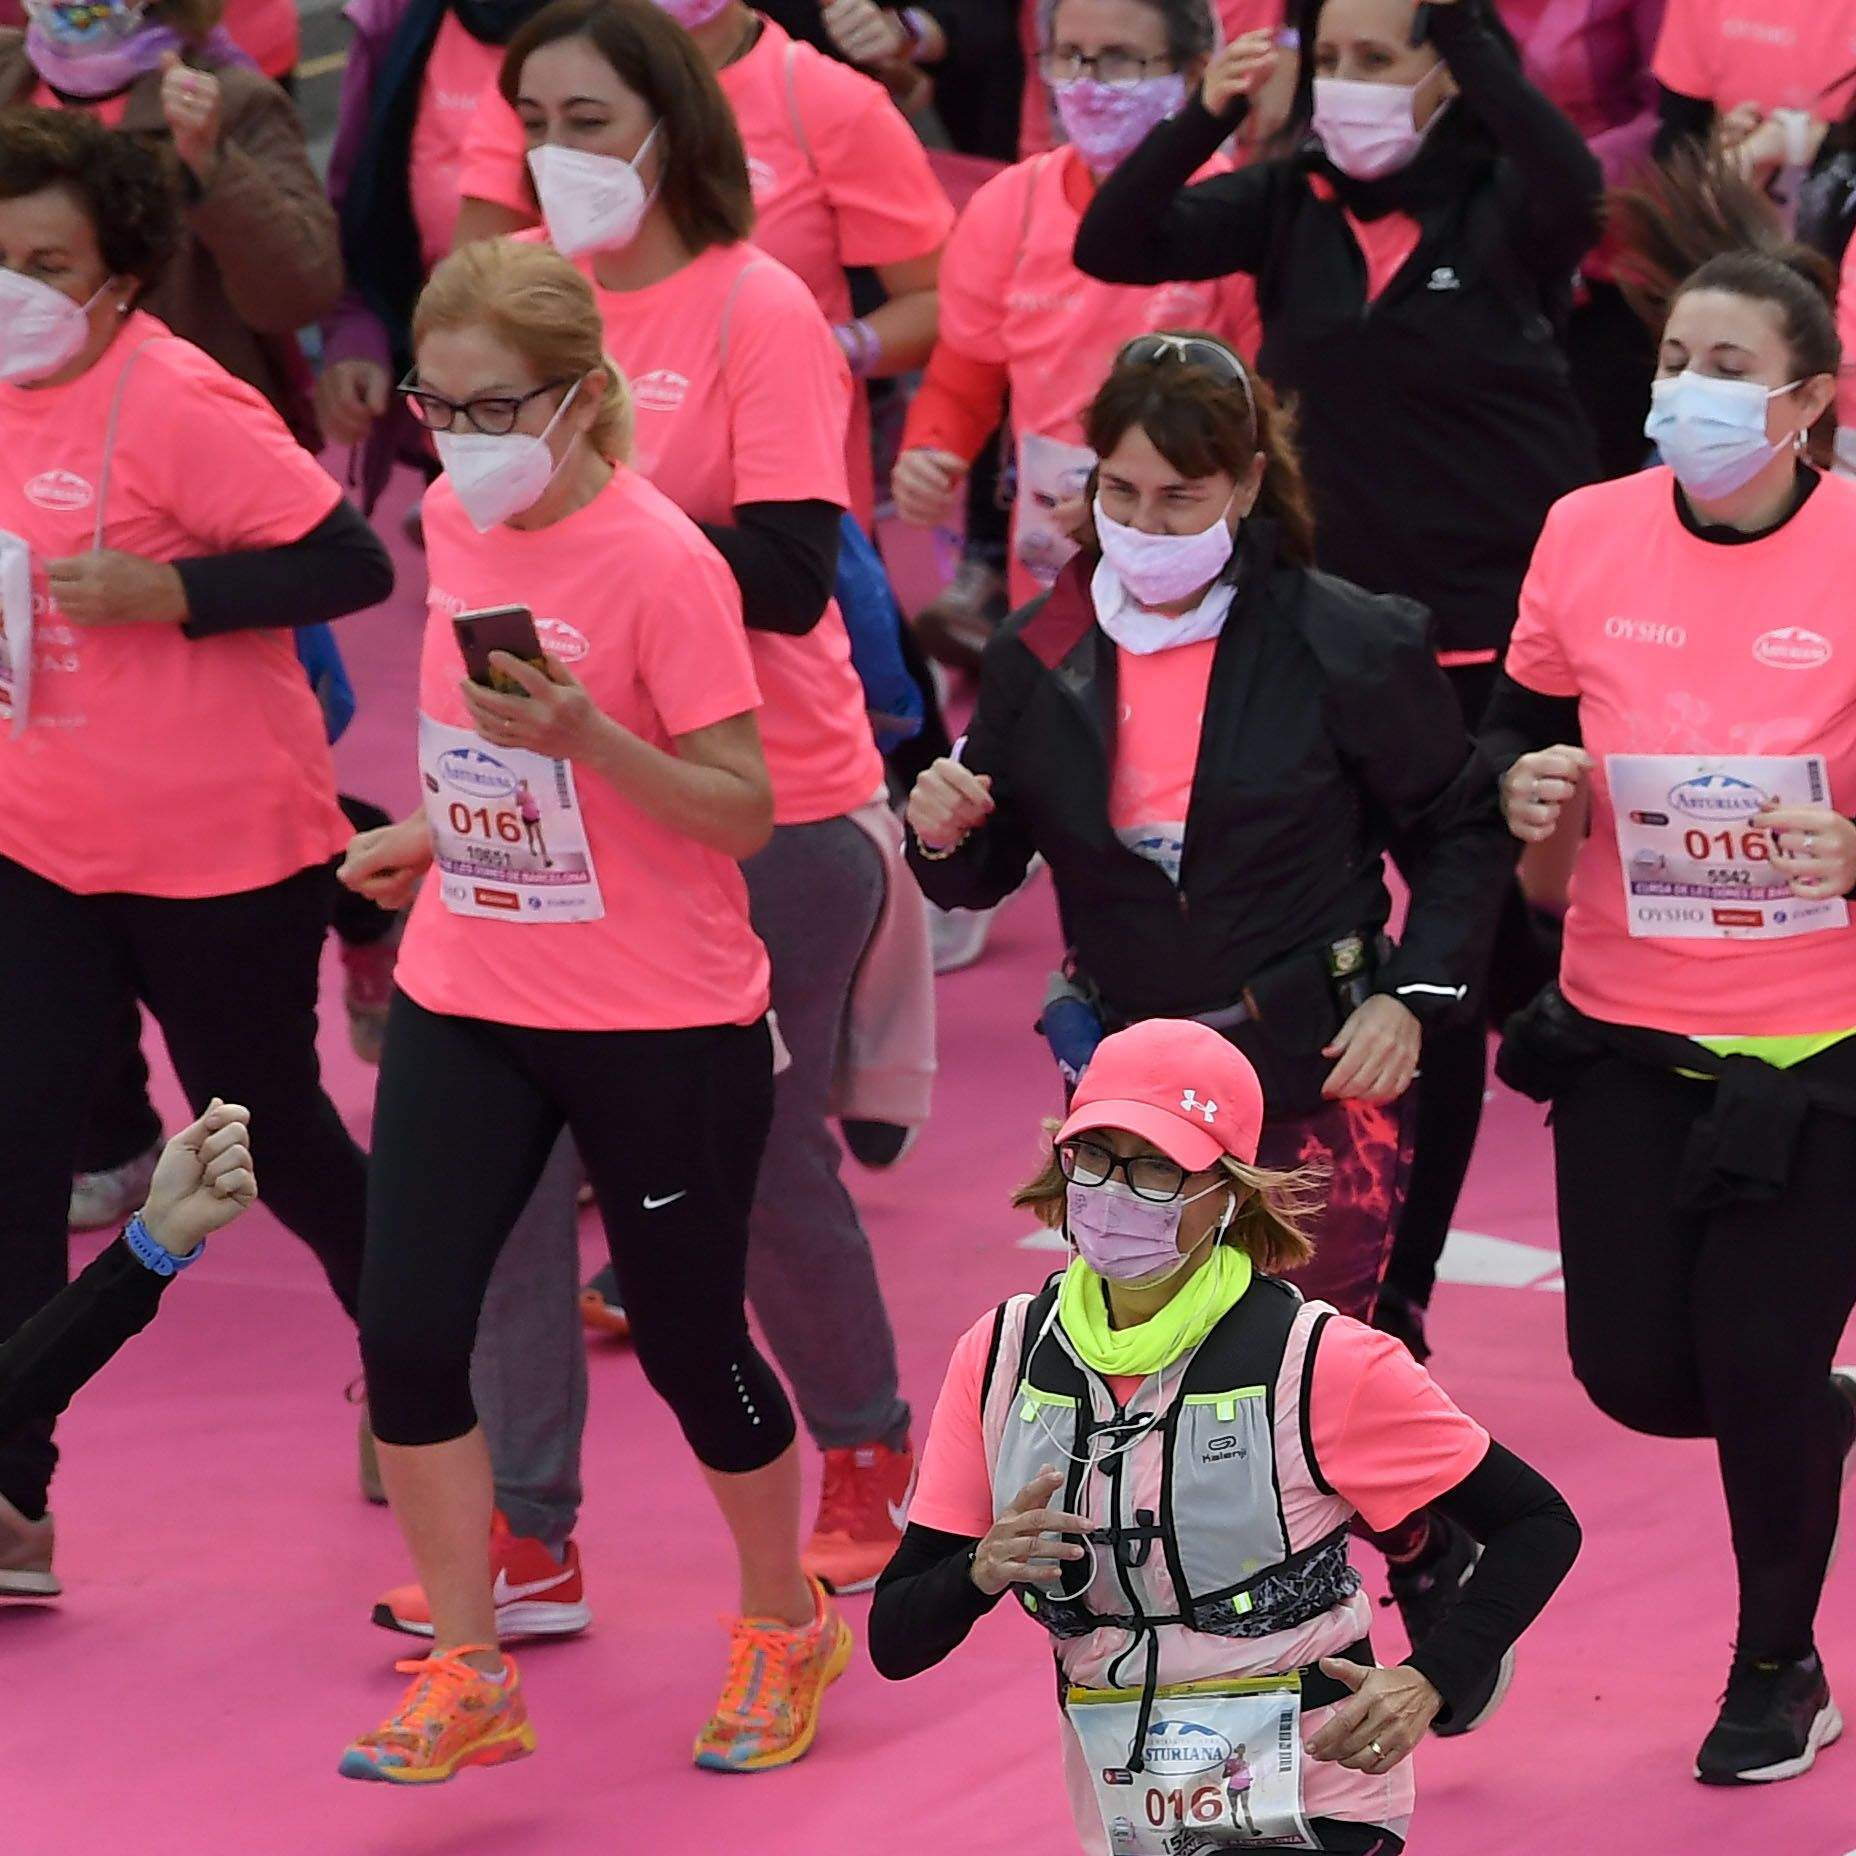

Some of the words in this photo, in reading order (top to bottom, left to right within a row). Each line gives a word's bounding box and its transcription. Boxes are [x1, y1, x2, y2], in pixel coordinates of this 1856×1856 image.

[1605, 616, 1688, 649] OYSHO
[449, 802, 522, 844] 016
[1684, 829, 1770, 862] 016
[1707, 869, 1751, 885] 5542
[1638, 908, 1704, 923] OYSHO
[1144, 1746, 1224, 1762] STURIANA
[1144, 1785, 1223, 1827] 016
